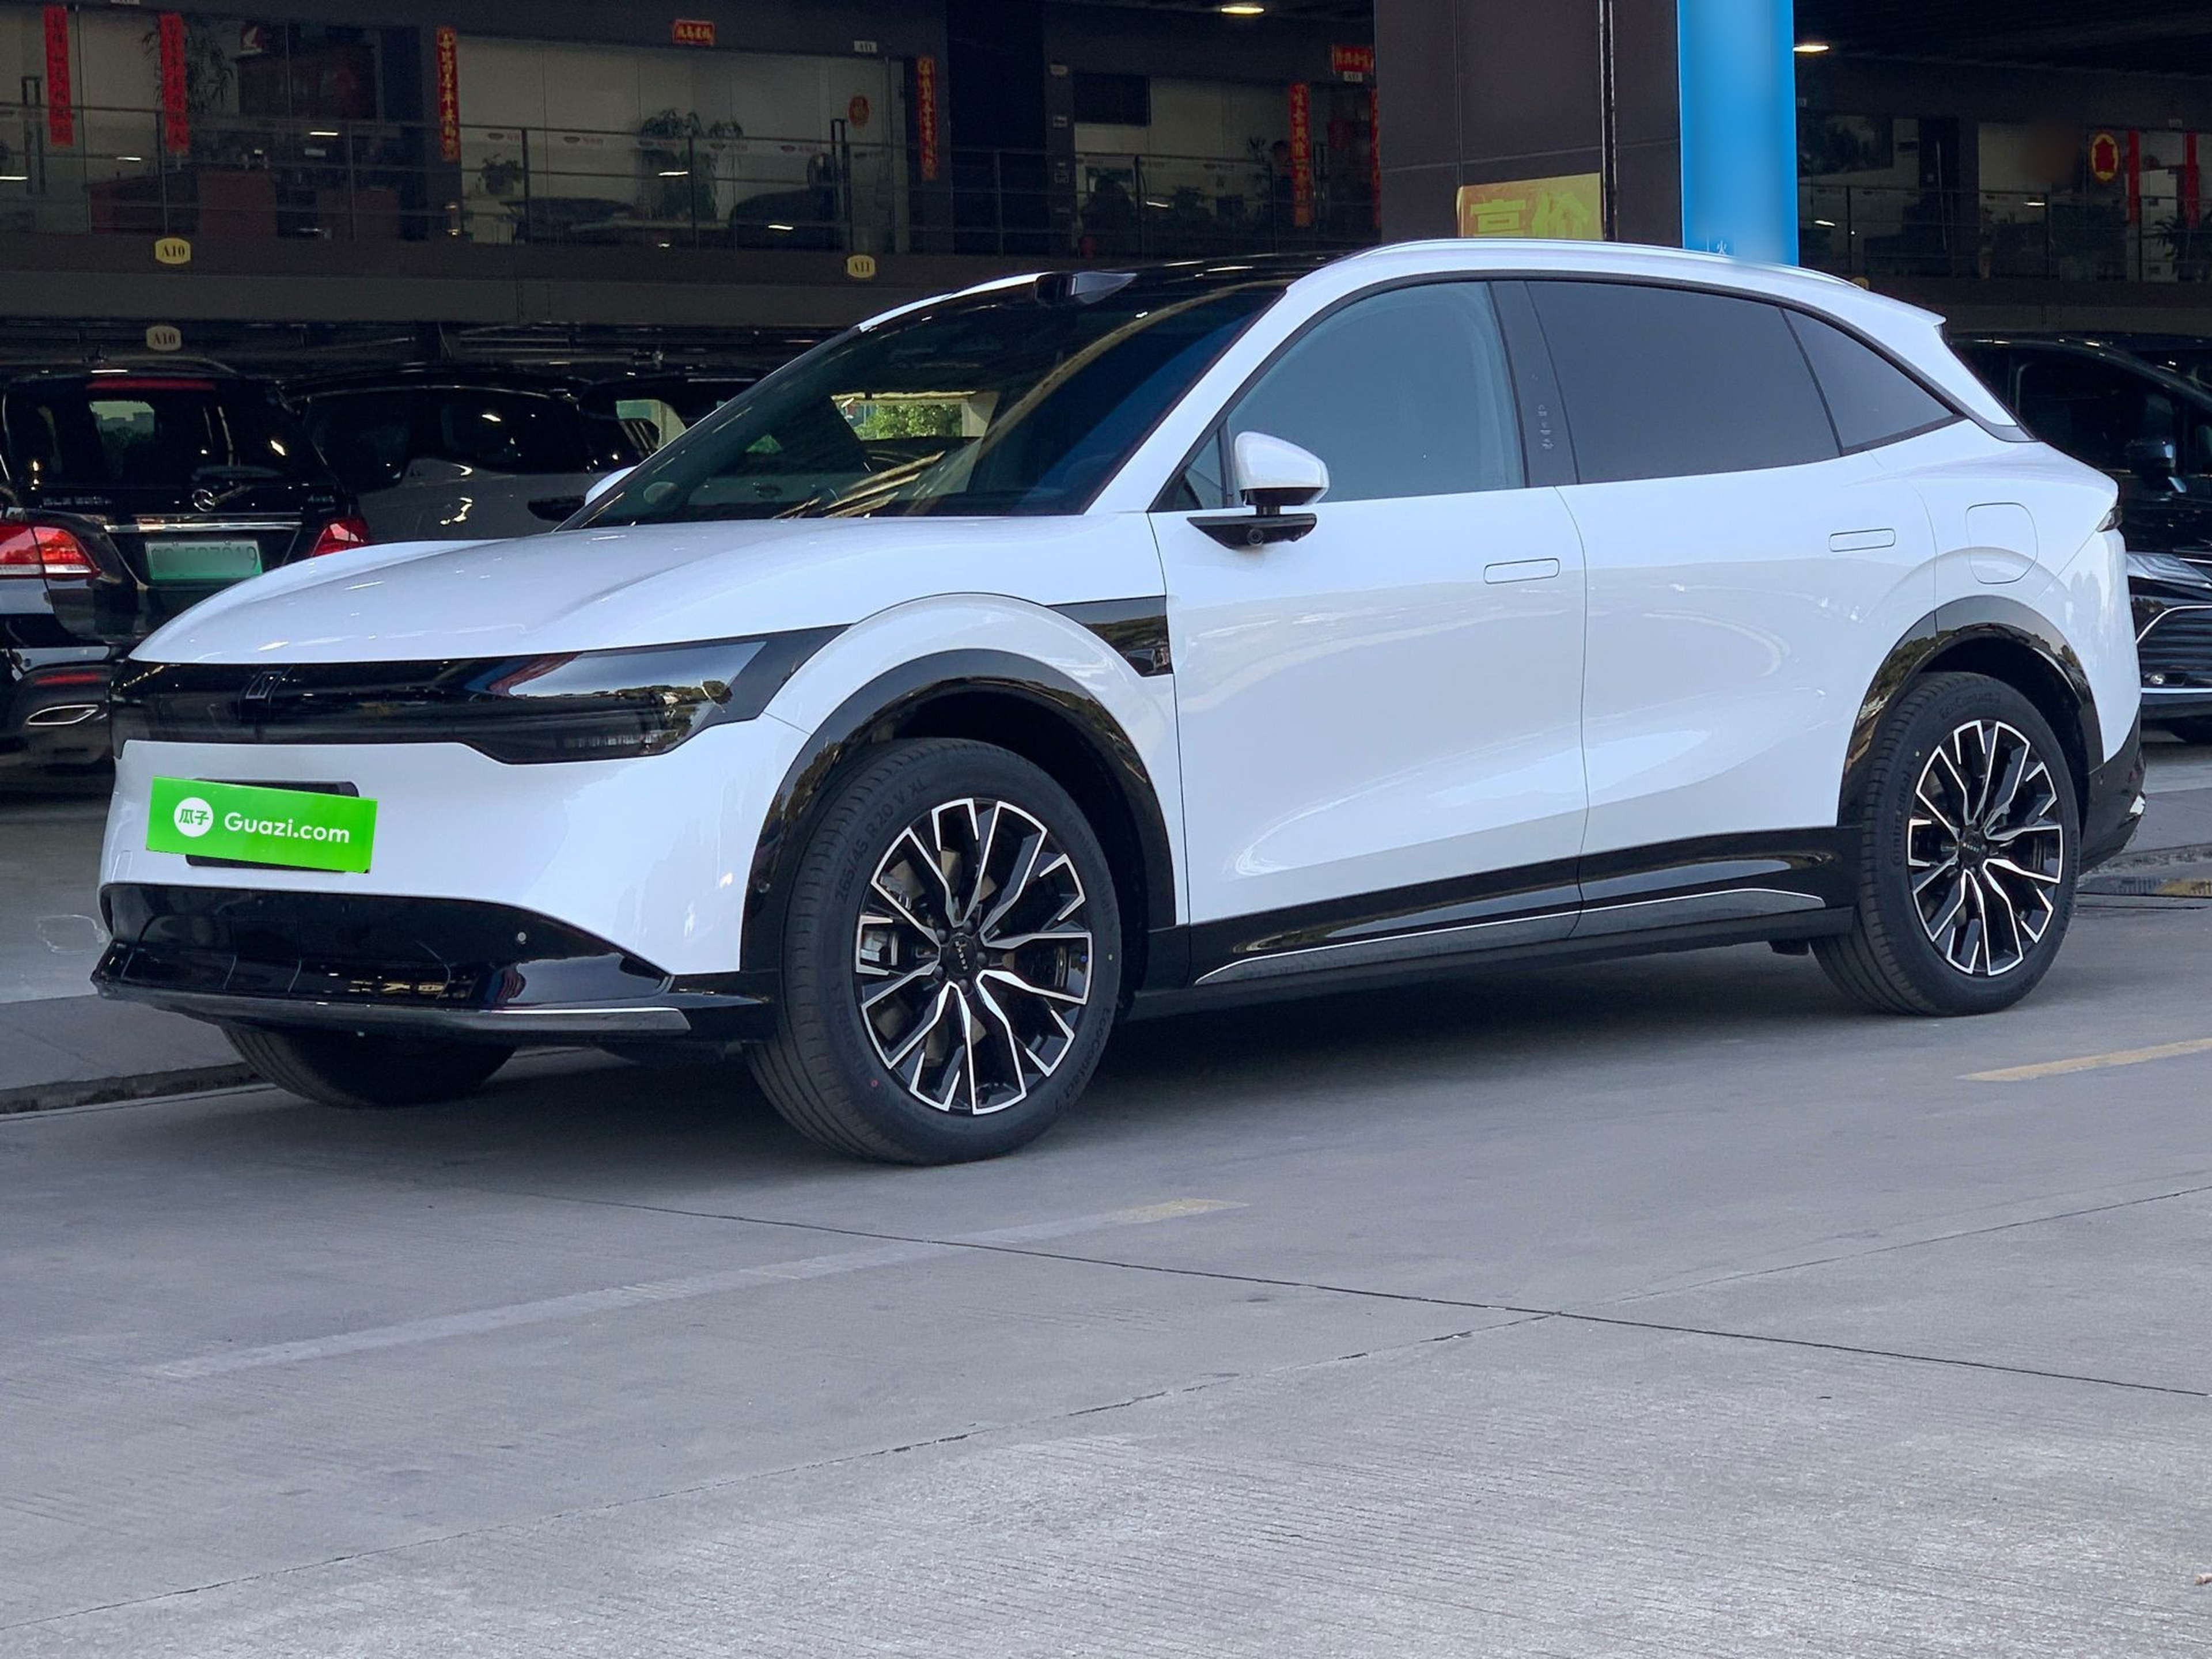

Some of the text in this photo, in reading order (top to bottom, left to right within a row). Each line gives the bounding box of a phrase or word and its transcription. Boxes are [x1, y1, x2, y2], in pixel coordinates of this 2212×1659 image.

[162, 245, 185, 257] A10
[853, 262, 870, 273] A11
[153, 333, 176, 345] A10
[834, 834, 869, 905] 265/45
